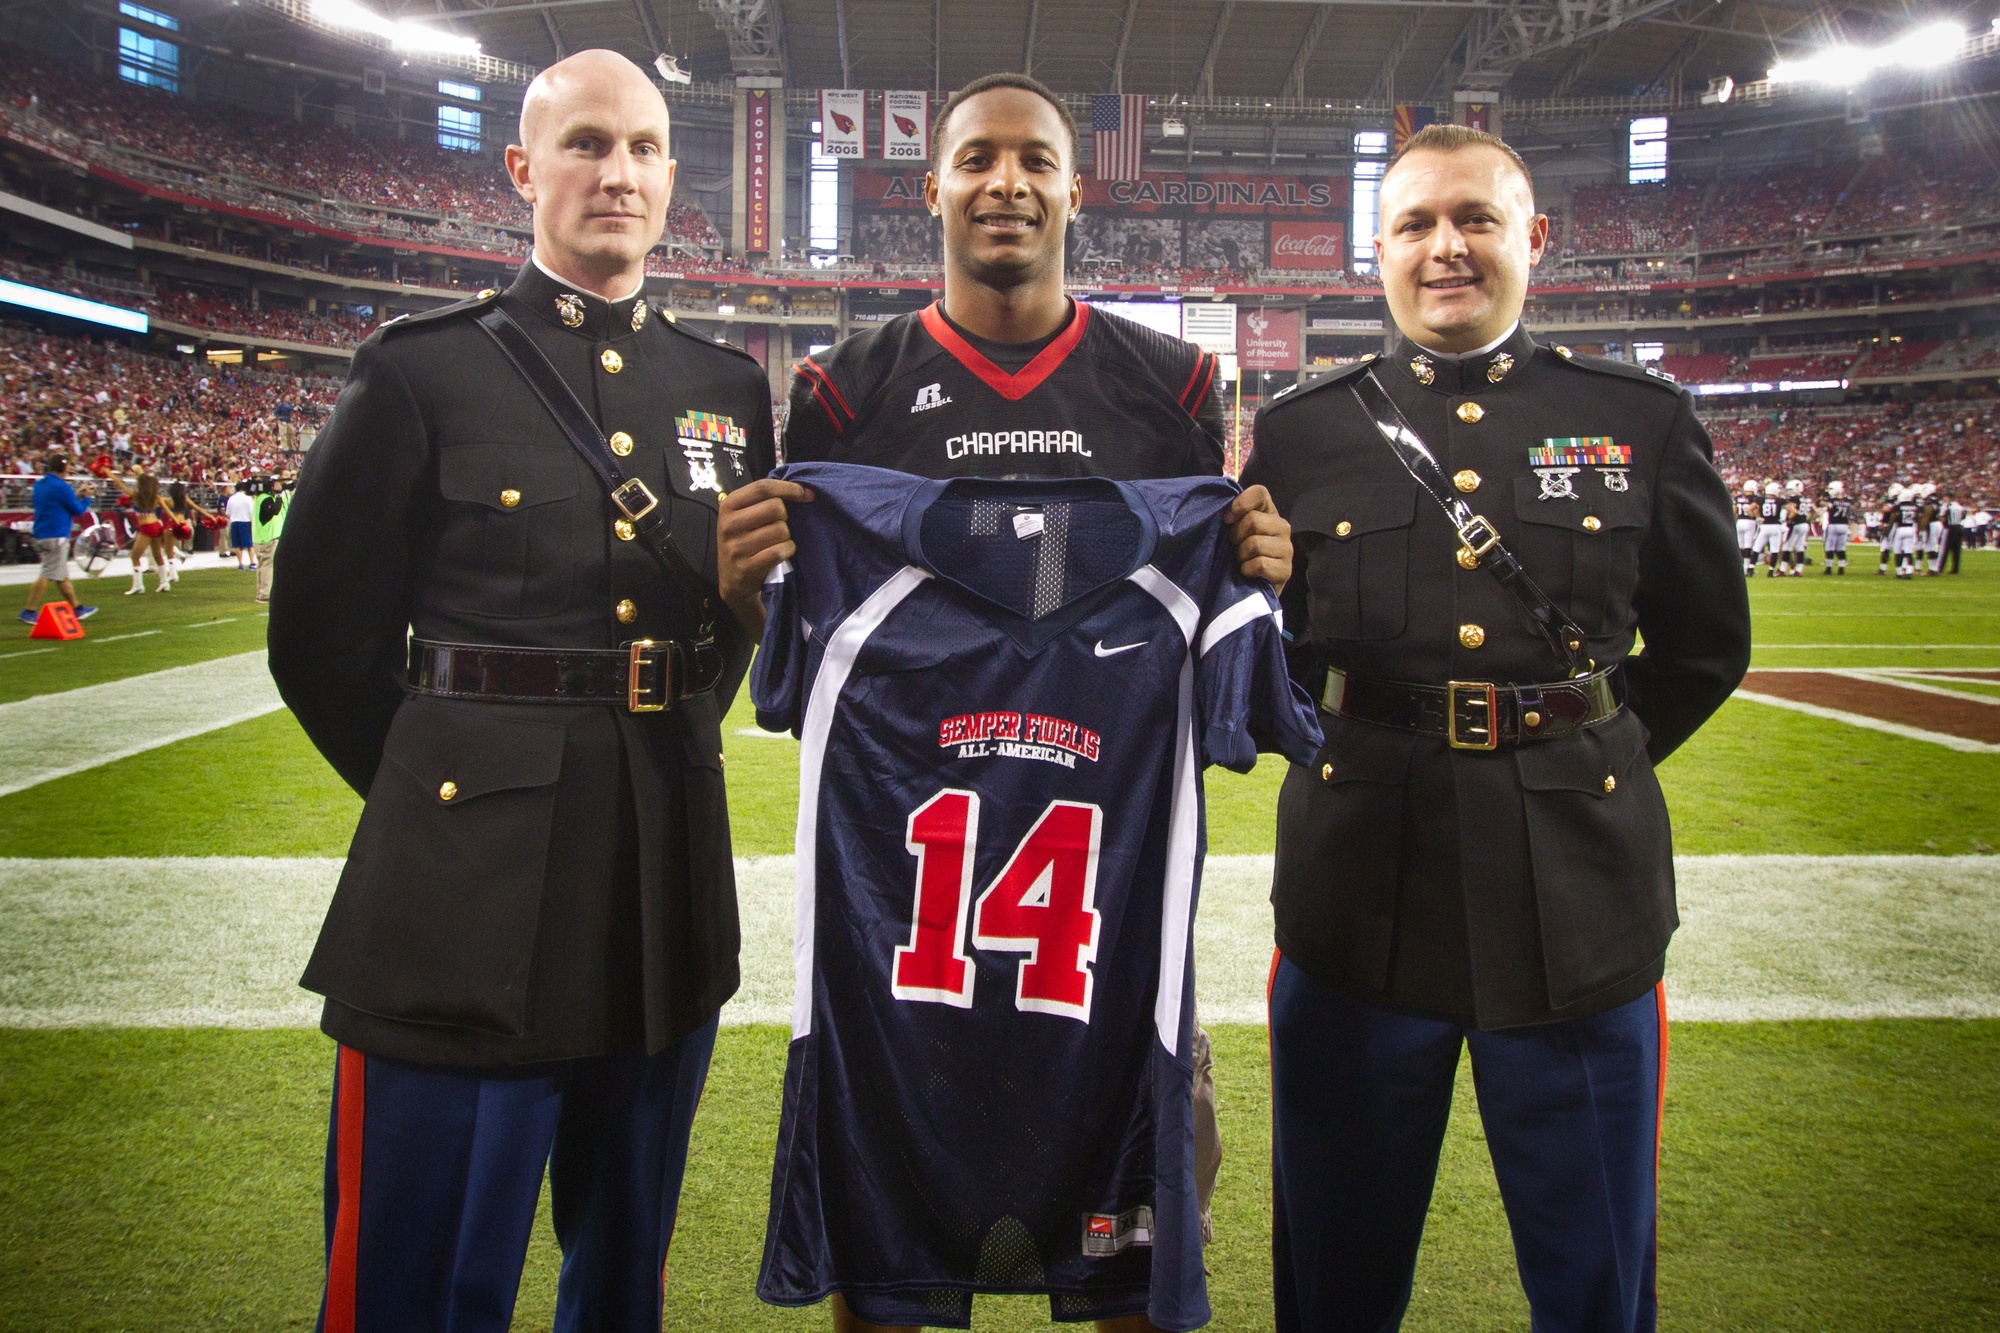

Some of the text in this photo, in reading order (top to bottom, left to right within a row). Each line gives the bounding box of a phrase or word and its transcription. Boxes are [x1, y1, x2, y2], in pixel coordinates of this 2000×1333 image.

[754, 106, 764, 199] FOOTBALL
[827, 145, 858, 155] 2008
[889, 147, 921, 156] 2008
[1109, 181, 1331, 206] CARDINALS
[1274, 234, 1339, 256] Coca-Cola
[1246, 339, 1287, 350] University
[1246, 349, 1289, 358] of Phoenix
[910, 396, 953, 413] RUSSELL
[946, 430, 1092, 459] CHAPARRAL
[1762, 503, 1777, 516] 81
[55, 606, 77, 634] G
[938, 711, 1100, 762] SEMPER FIDELIS
[958, 742, 1076, 769] ALL-AMERICAN
[891, 787, 1103, 1024] 14
